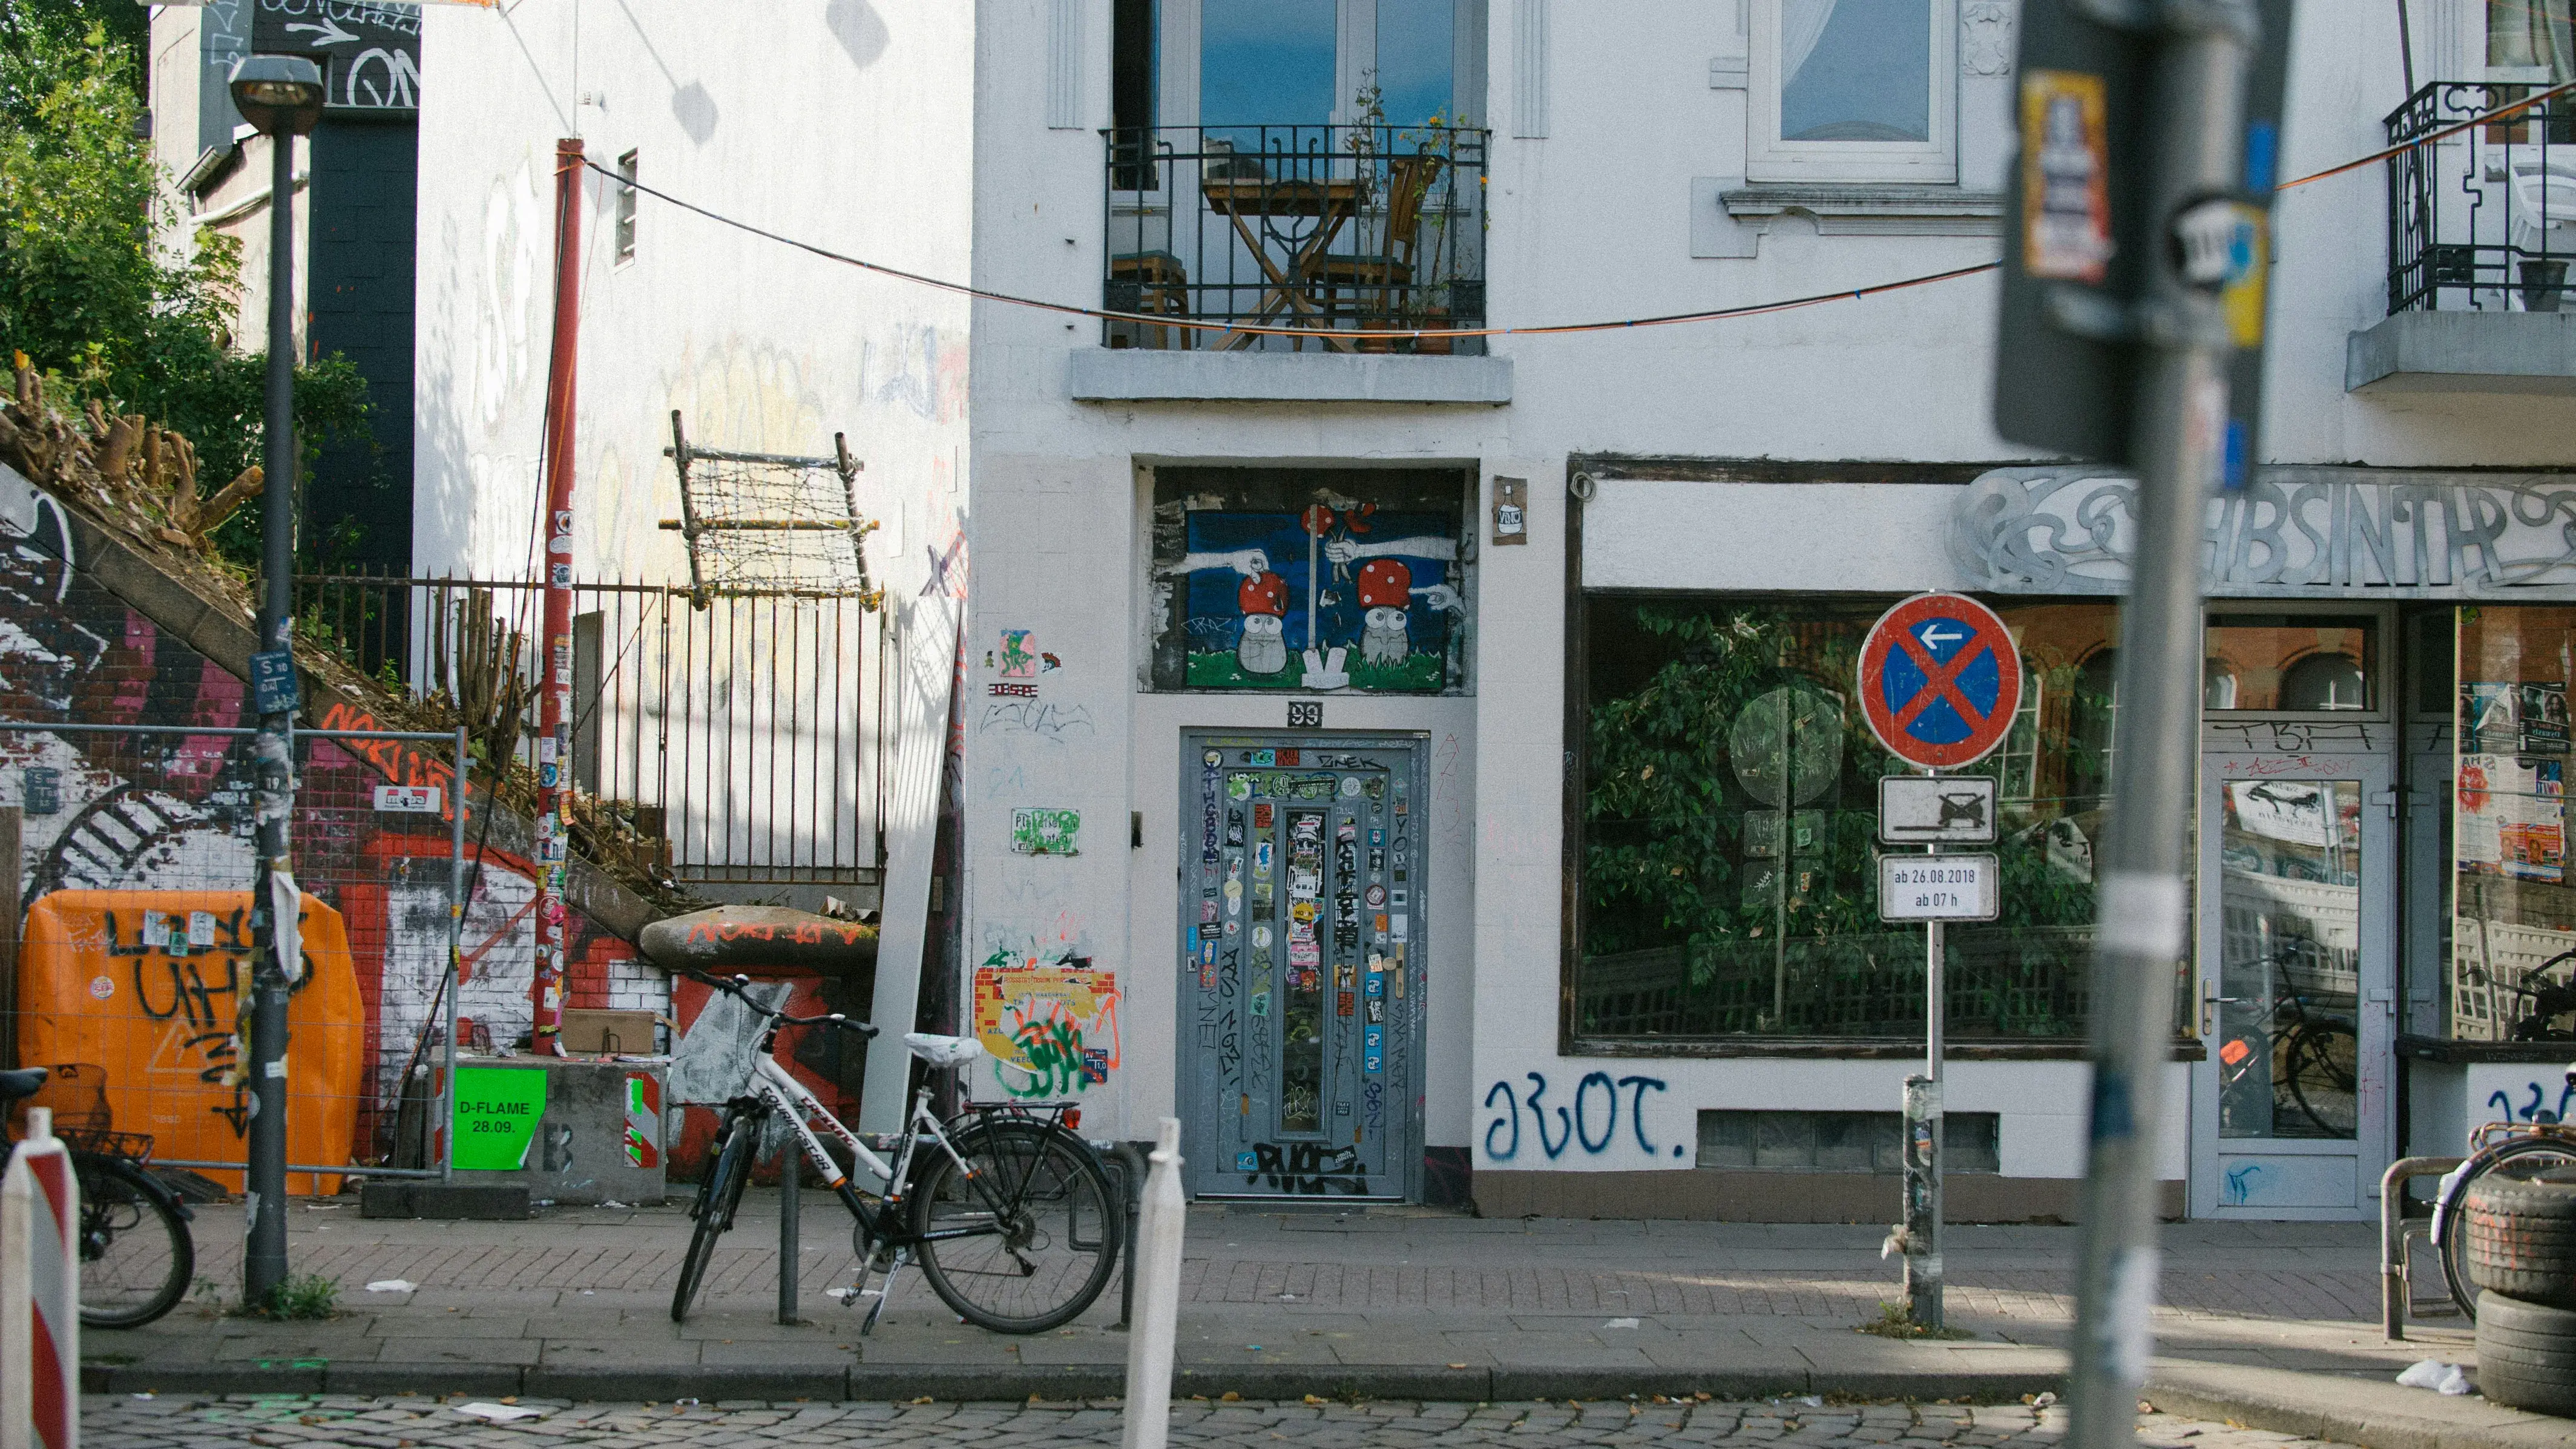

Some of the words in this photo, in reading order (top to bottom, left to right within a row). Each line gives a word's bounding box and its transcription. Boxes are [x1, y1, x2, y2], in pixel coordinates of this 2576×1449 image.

[1292, 704, 1318, 725] 99
[1894, 870, 1907, 883] ab
[1912, 870, 1975, 883] 26.08.2018
[1916, 893, 1928, 906] ab
[1933, 893, 1947, 907] 07
[1951, 893, 1957, 906] h
[459, 1102, 530, 1115] D-FLAME
[472, 1121, 516, 1133] 28.09.
[761, 1085, 831, 1171] TOURINGSTAR
[801, 1096, 858, 1147] TREKKING
